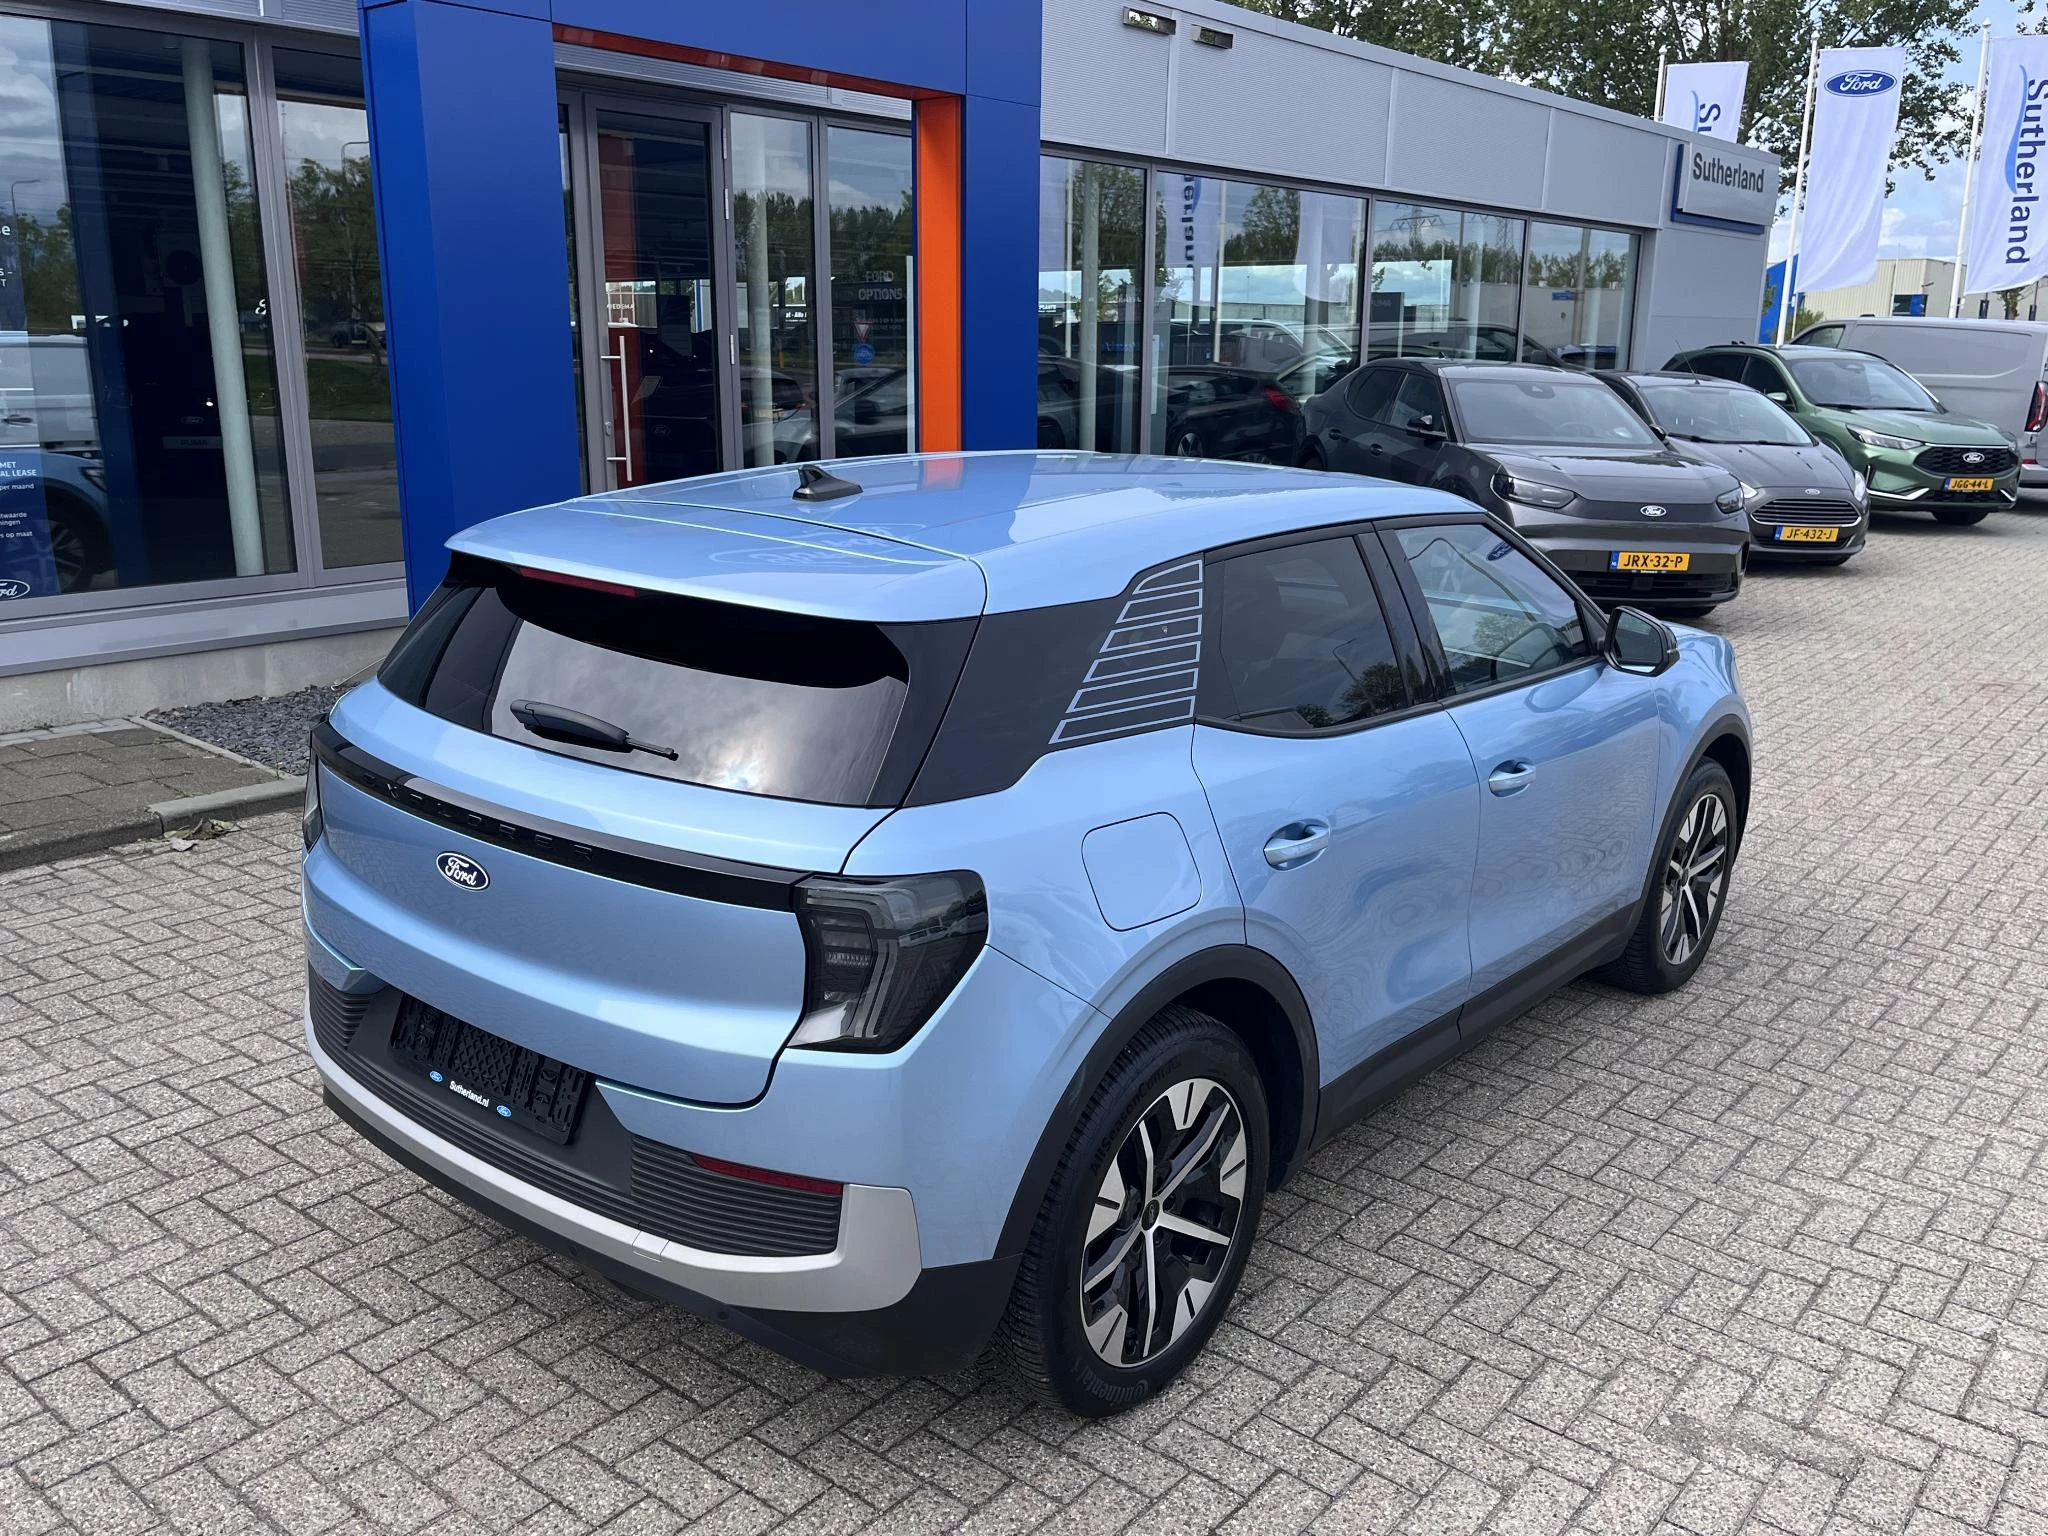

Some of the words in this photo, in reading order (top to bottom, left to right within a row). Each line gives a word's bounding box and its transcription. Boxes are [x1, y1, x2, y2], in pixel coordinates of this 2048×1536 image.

[1840, 73, 1883, 91] Ford
[1693, 152, 1765, 193] Sutherland
[2005, 79, 2048, 264] Sutherland
[858, 288, 903, 300] OPTIONS
[12, 469, 37, 477] LEASE
[1787, 529, 1833, 540] JF-432-J
[1624, 555, 1683, 568] JRX-32-P
[445, 857, 477, 885] Ford
[449, 1080, 490, 1108] Sutherland.nl
